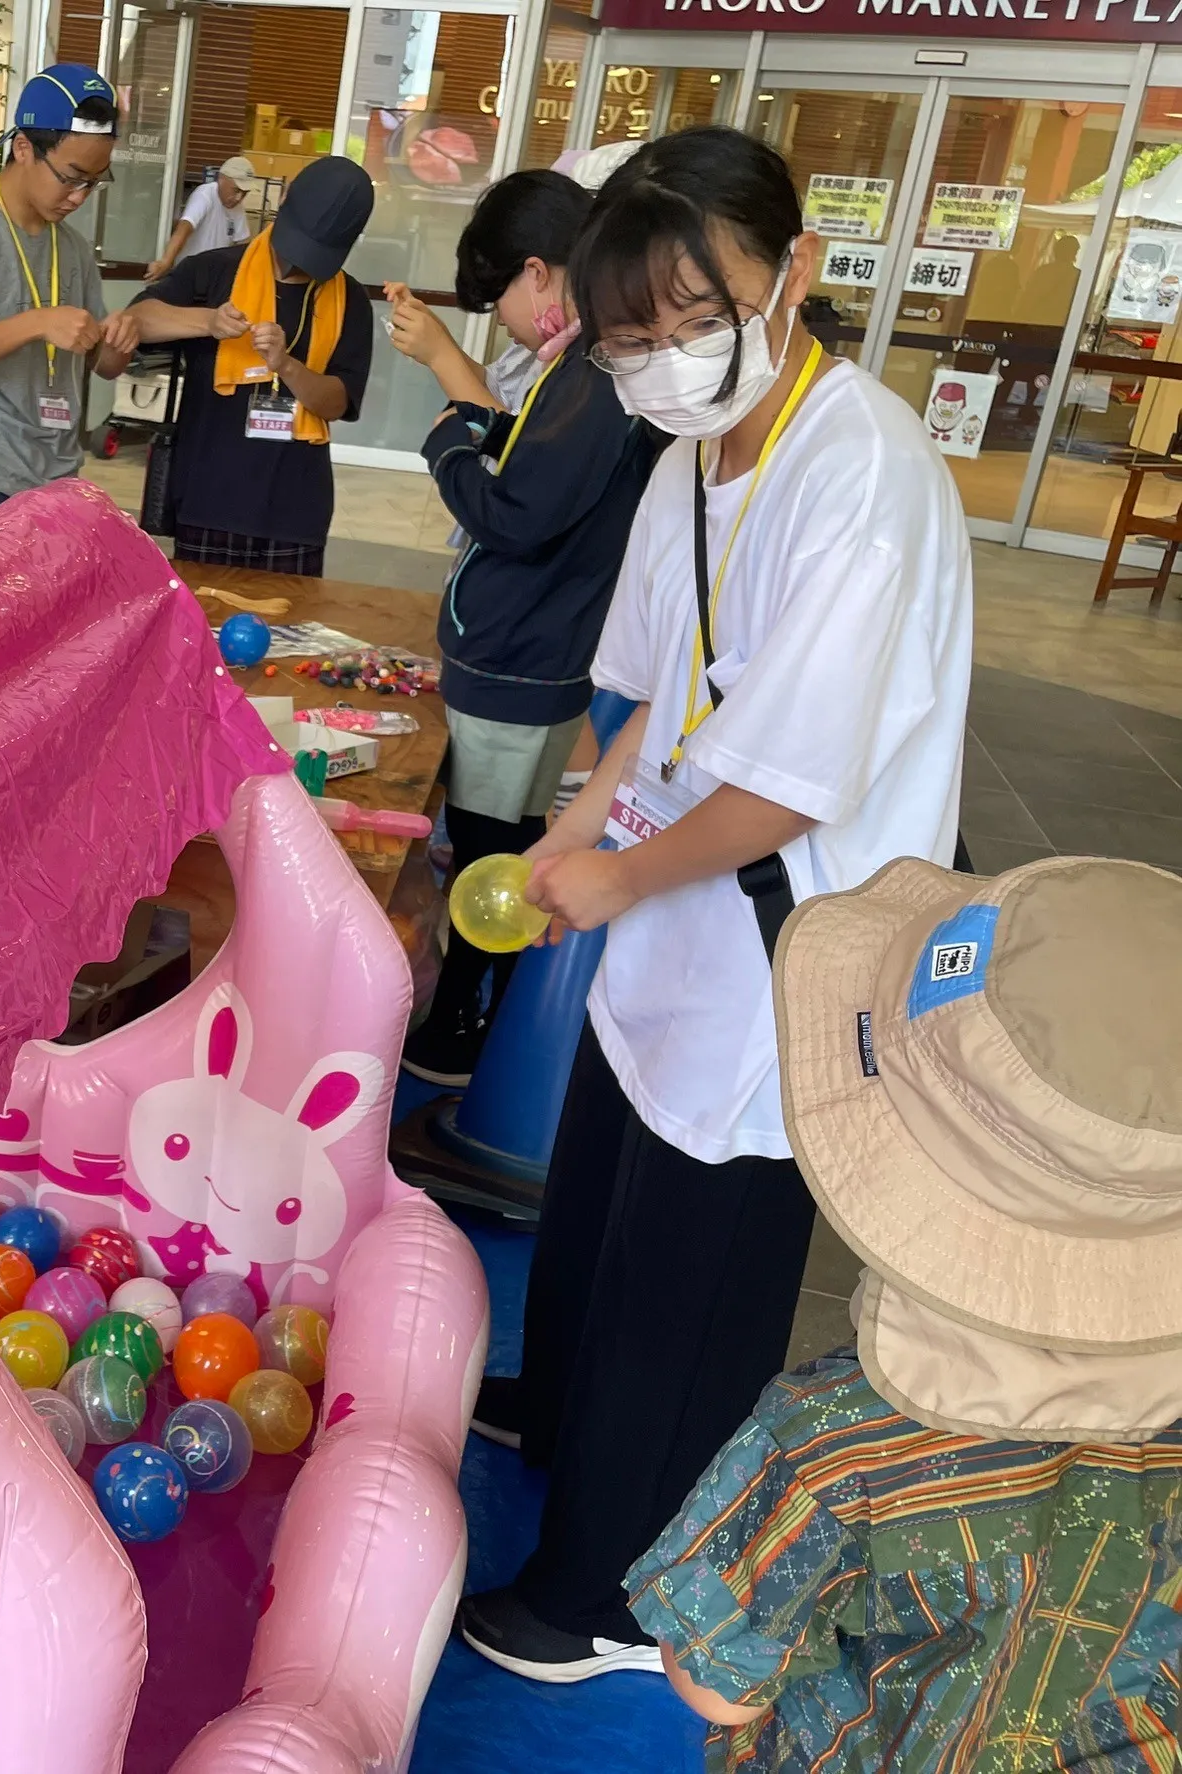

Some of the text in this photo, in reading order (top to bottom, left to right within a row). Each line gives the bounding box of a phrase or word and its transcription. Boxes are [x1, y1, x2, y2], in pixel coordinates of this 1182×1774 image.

[543, 57, 650, 96] YAKO
[827, 254, 876, 280] 締切
[911, 262, 963, 287] 締切
[43, 408, 67, 420] STAFF
[254, 420, 288, 431] STAFF
[938, 953, 949, 974] fant
[960, 952, 972, 973] HIPO
